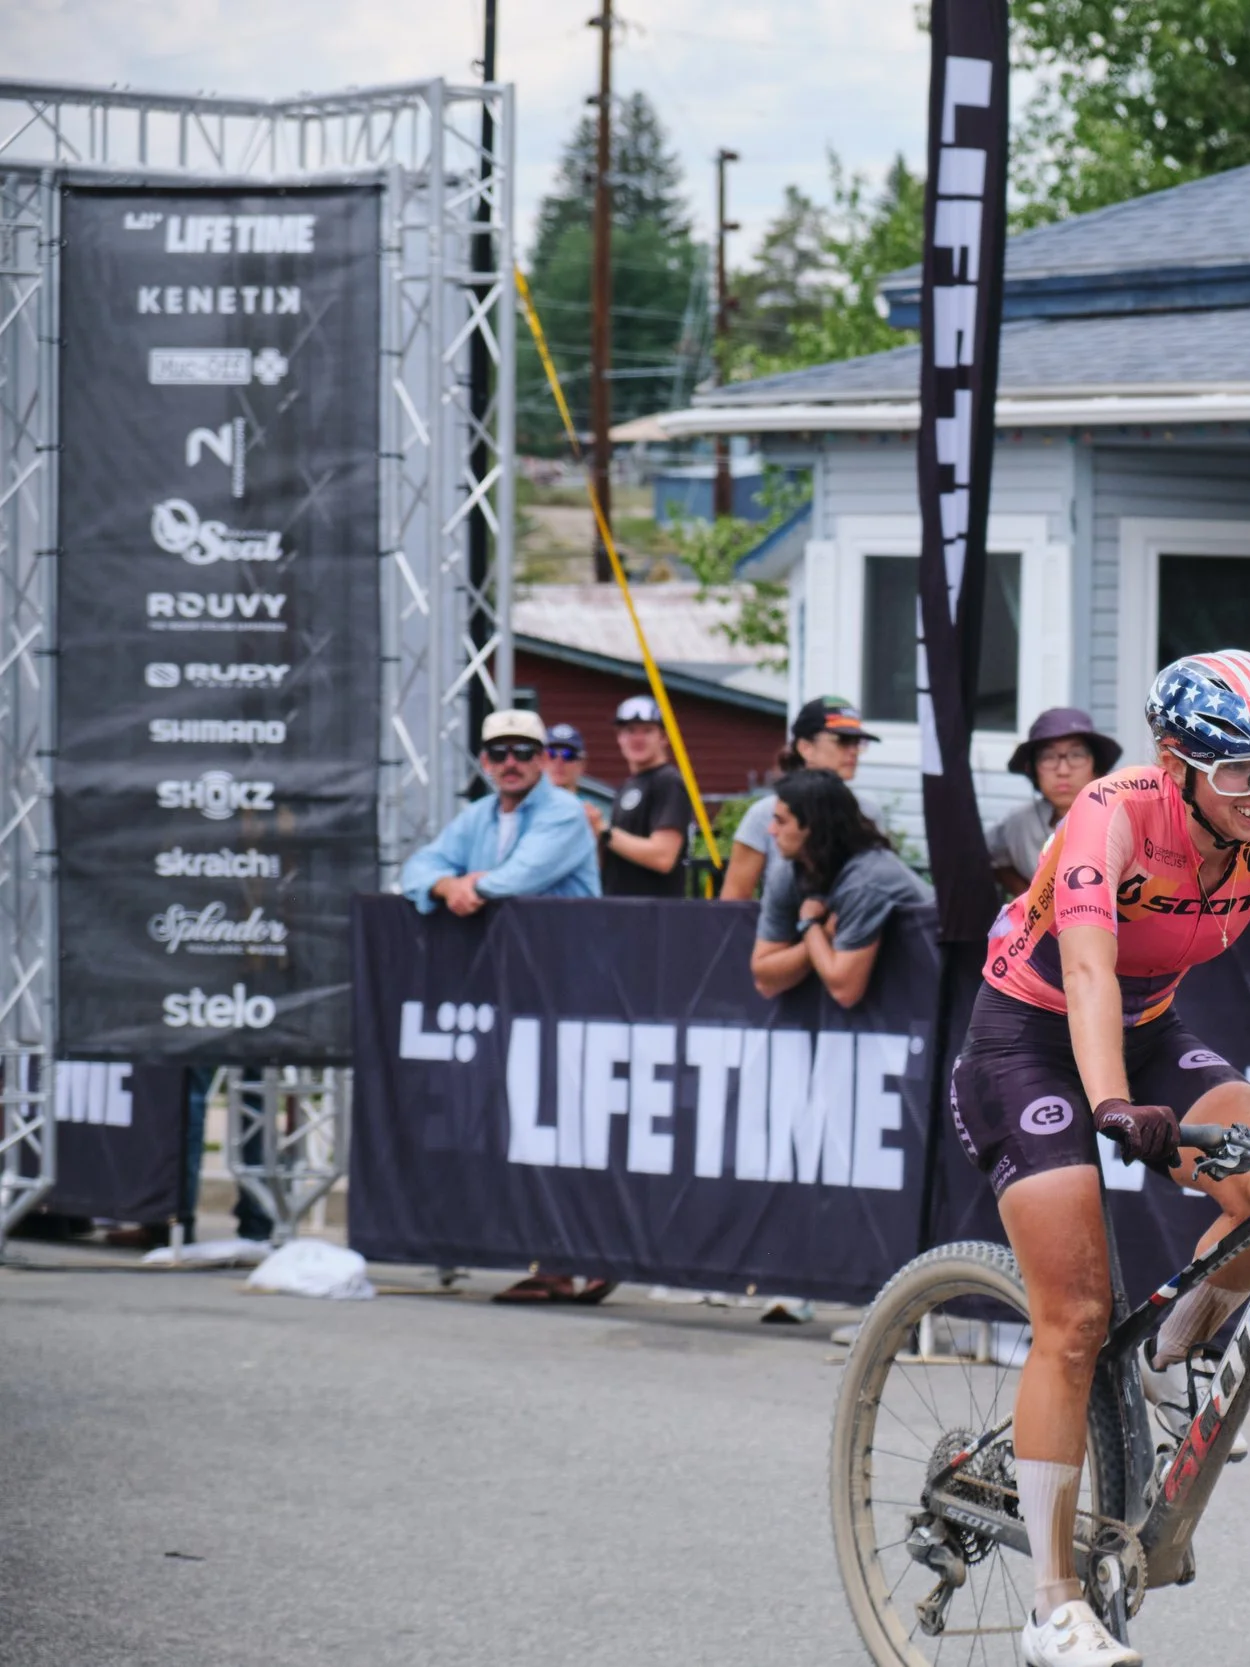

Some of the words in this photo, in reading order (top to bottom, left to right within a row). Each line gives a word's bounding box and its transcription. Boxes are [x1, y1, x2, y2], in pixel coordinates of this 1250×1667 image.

[146, 591, 288, 618] ROUVY
[184, 662, 290, 682] RUDY
[149, 718, 287, 744] SHIMANO
[156, 779, 275, 811] SHOKZ
[1110, 779, 1160, 791] KENDA
[162, 982, 276, 1029] stelo
[944, 1504, 1003, 1535] SCOTT
